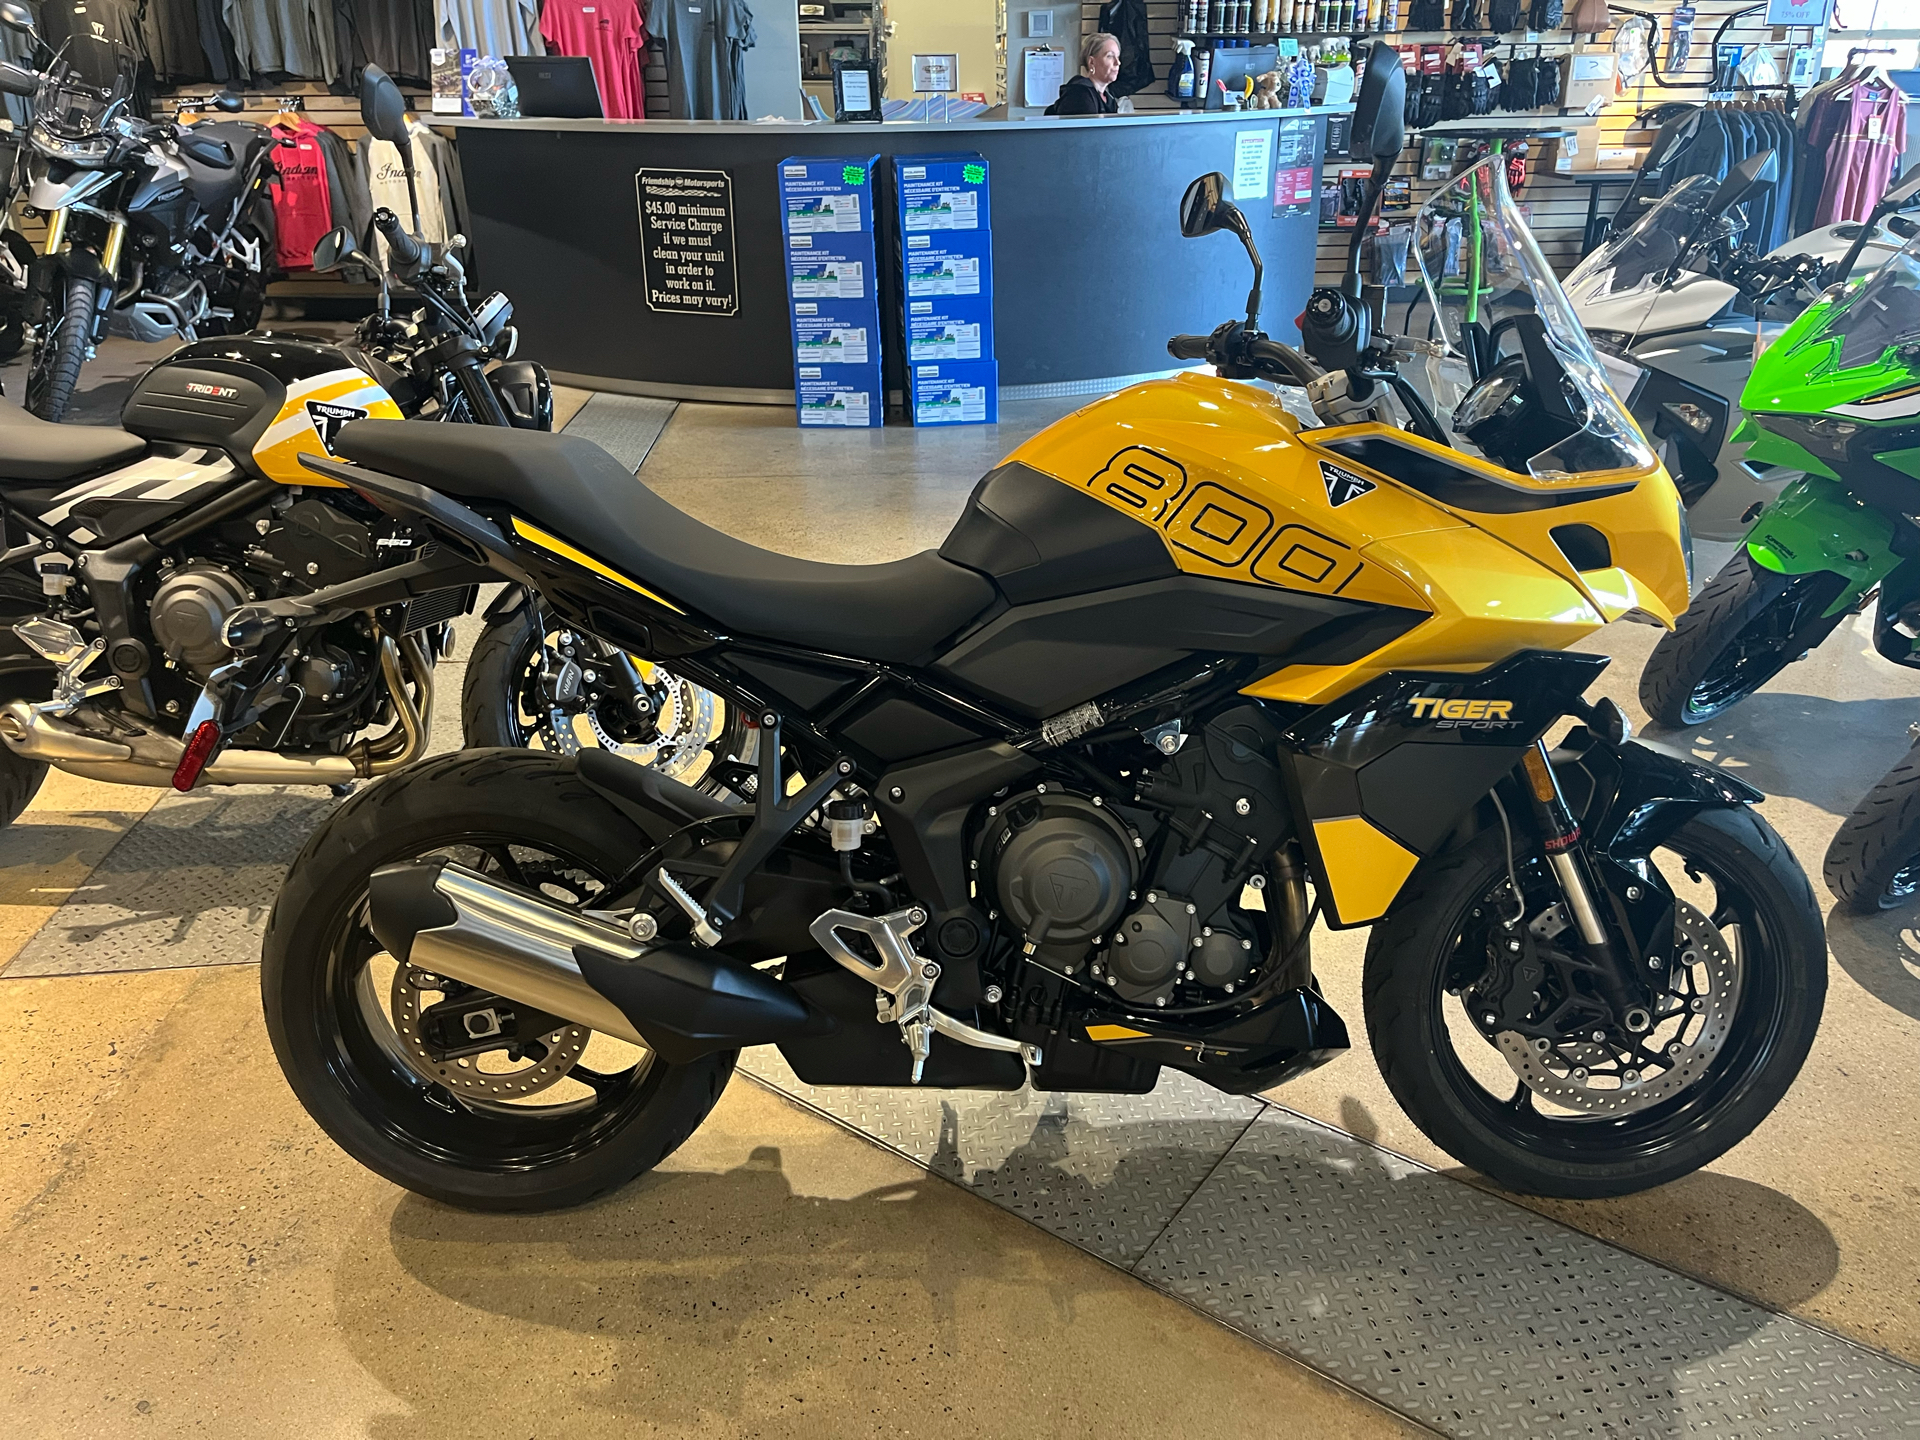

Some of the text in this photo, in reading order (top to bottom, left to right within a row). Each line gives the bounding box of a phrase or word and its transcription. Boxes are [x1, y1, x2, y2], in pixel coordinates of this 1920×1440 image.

[274, 161, 318, 176] Indian
[642, 176, 724, 188] Friendship Motorsports
[645, 200, 726, 216] $45.00 minimum
[650, 216, 723, 234] Service Charge
[663, 232, 712, 247] if we must
[653, 246, 725, 263] clean your unit
[665, 262, 714, 276] in order to
[666, 277, 716, 291] work on it.
[652, 290, 732, 309] Prices may vary!
[186, 382, 238, 398] TRIDENT
[316, 404, 355, 418] TRIUMPH
[1329, 465, 1365, 486] TRIUMPH
[1087, 444, 1365, 595] 800
[1409, 697, 1513, 720] TIGER
[1435, 720, 1524, 729] SPORT
